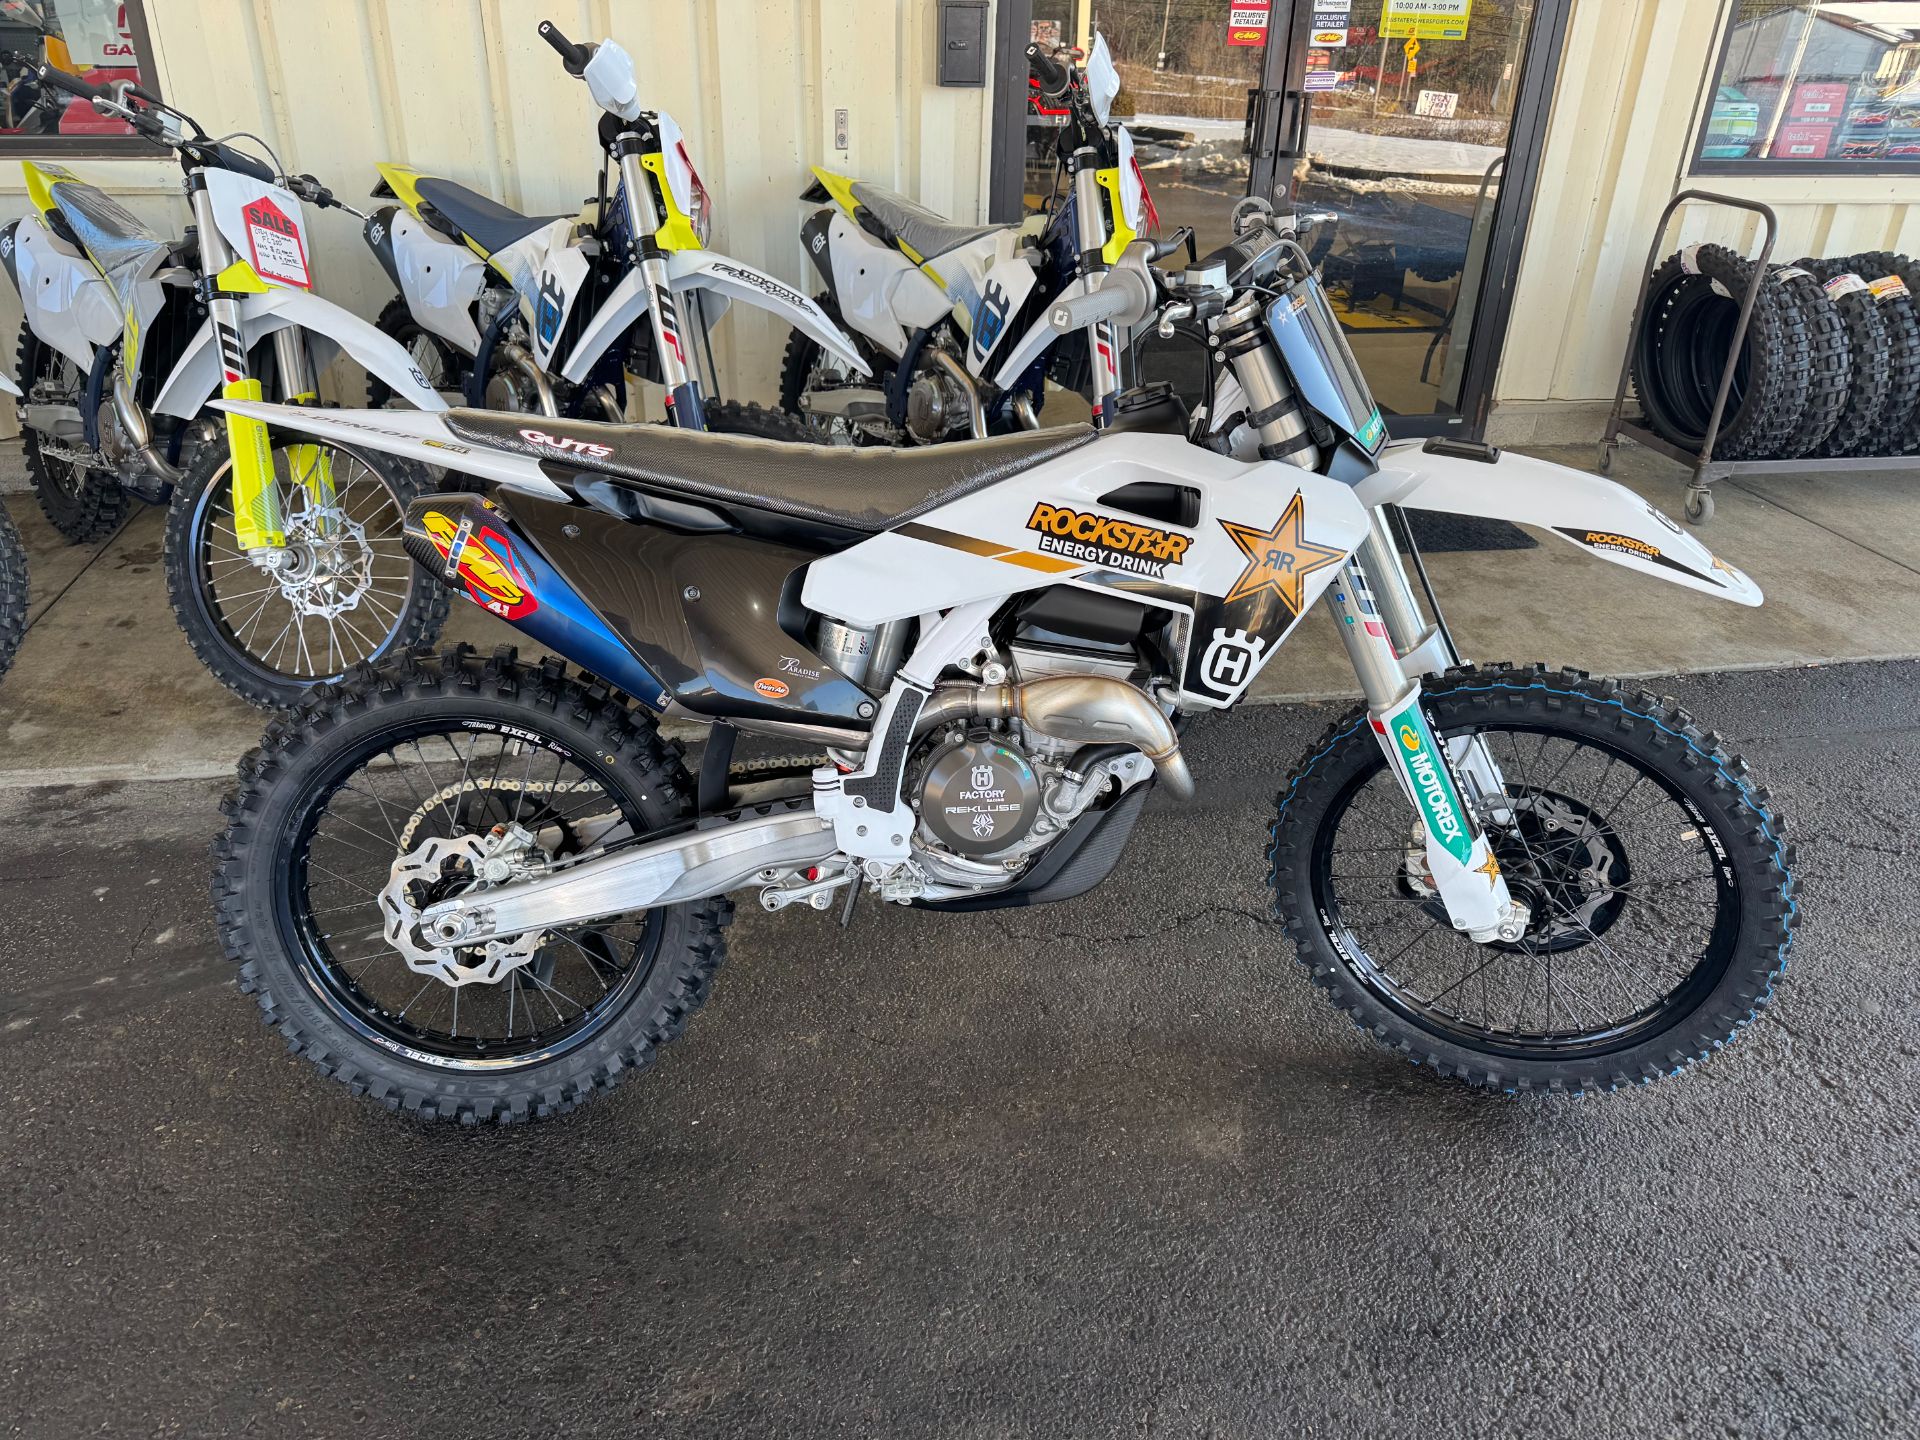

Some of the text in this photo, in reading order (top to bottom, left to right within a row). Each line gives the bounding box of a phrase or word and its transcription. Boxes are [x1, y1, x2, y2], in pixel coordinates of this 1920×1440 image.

[1396, 2, 1413, 10] 10:00
[249, 208, 294, 235] SALE
[311, 415, 419, 440] DUNLOP
[519, 429, 615, 457] GUTS
[1028, 504, 1189, 563] ROCKSTAR
[1585, 532, 1660, 557] ROCKSTAR
[1041, 536, 1165, 578] ENERGY DRINK
[1593, 542, 1653, 561] ENERGY DRINK
[757, 682, 787, 694] Twin Air
[500, 725, 542, 744] EXCEL
[959, 790, 1006, 799] FACTORY
[1408, 752, 1463, 844] MOTOREX
[945, 803, 1022, 814] REKLUSE
[1703, 826, 1728, 861] EXCEL
[1328, 930, 1350, 961] EXCEL
[404, 1048, 444, 1066] EXCEL
